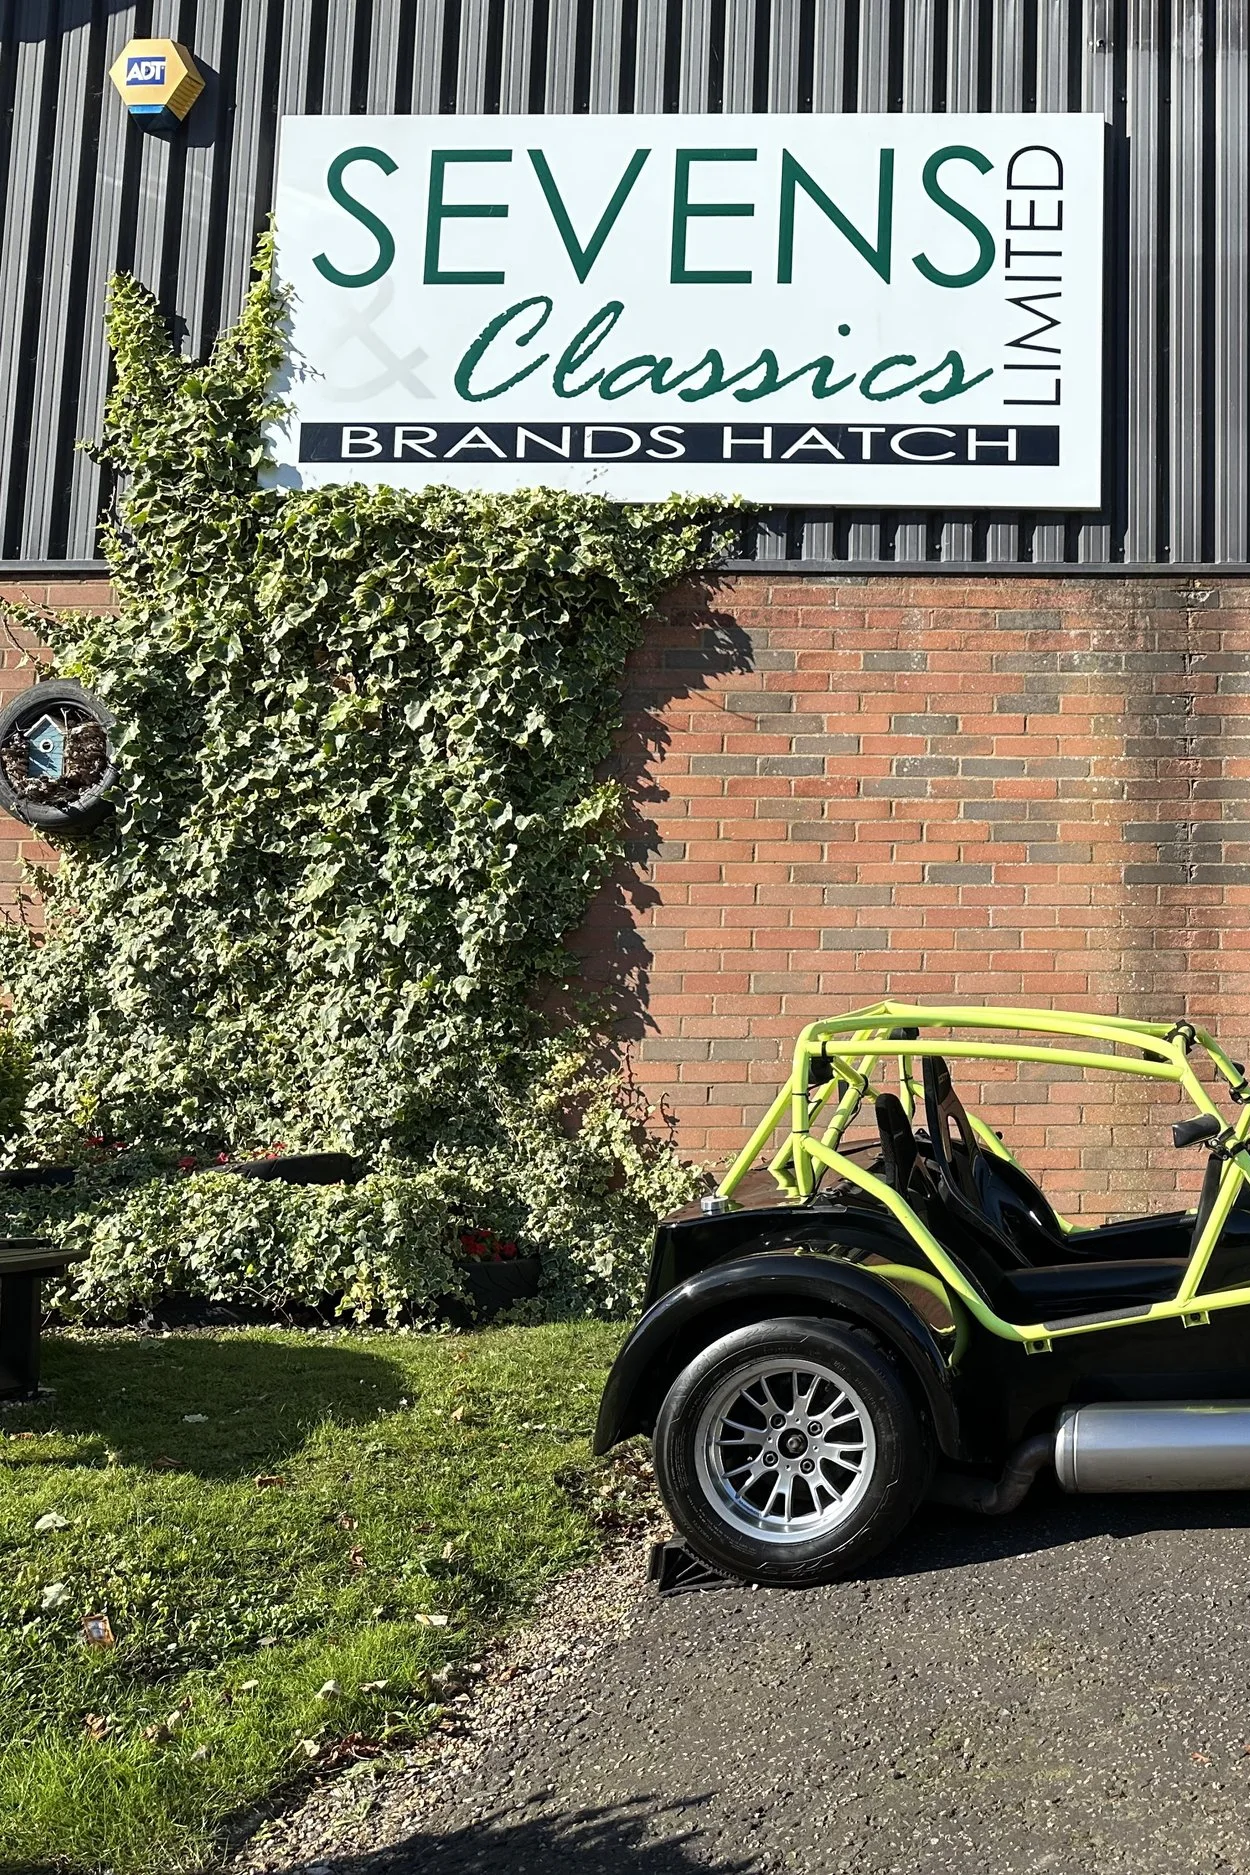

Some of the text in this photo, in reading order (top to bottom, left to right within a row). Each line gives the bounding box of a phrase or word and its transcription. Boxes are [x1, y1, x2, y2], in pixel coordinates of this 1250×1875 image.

[126, 61, 166, 81] ADT
[313, 145, 995, 288] SEVENS
[1003, 145, 1063, 405] LIMITED
[454, 296, 993, 404] Classics
[341, 426, 1016, 461] BRANDS HATCH
